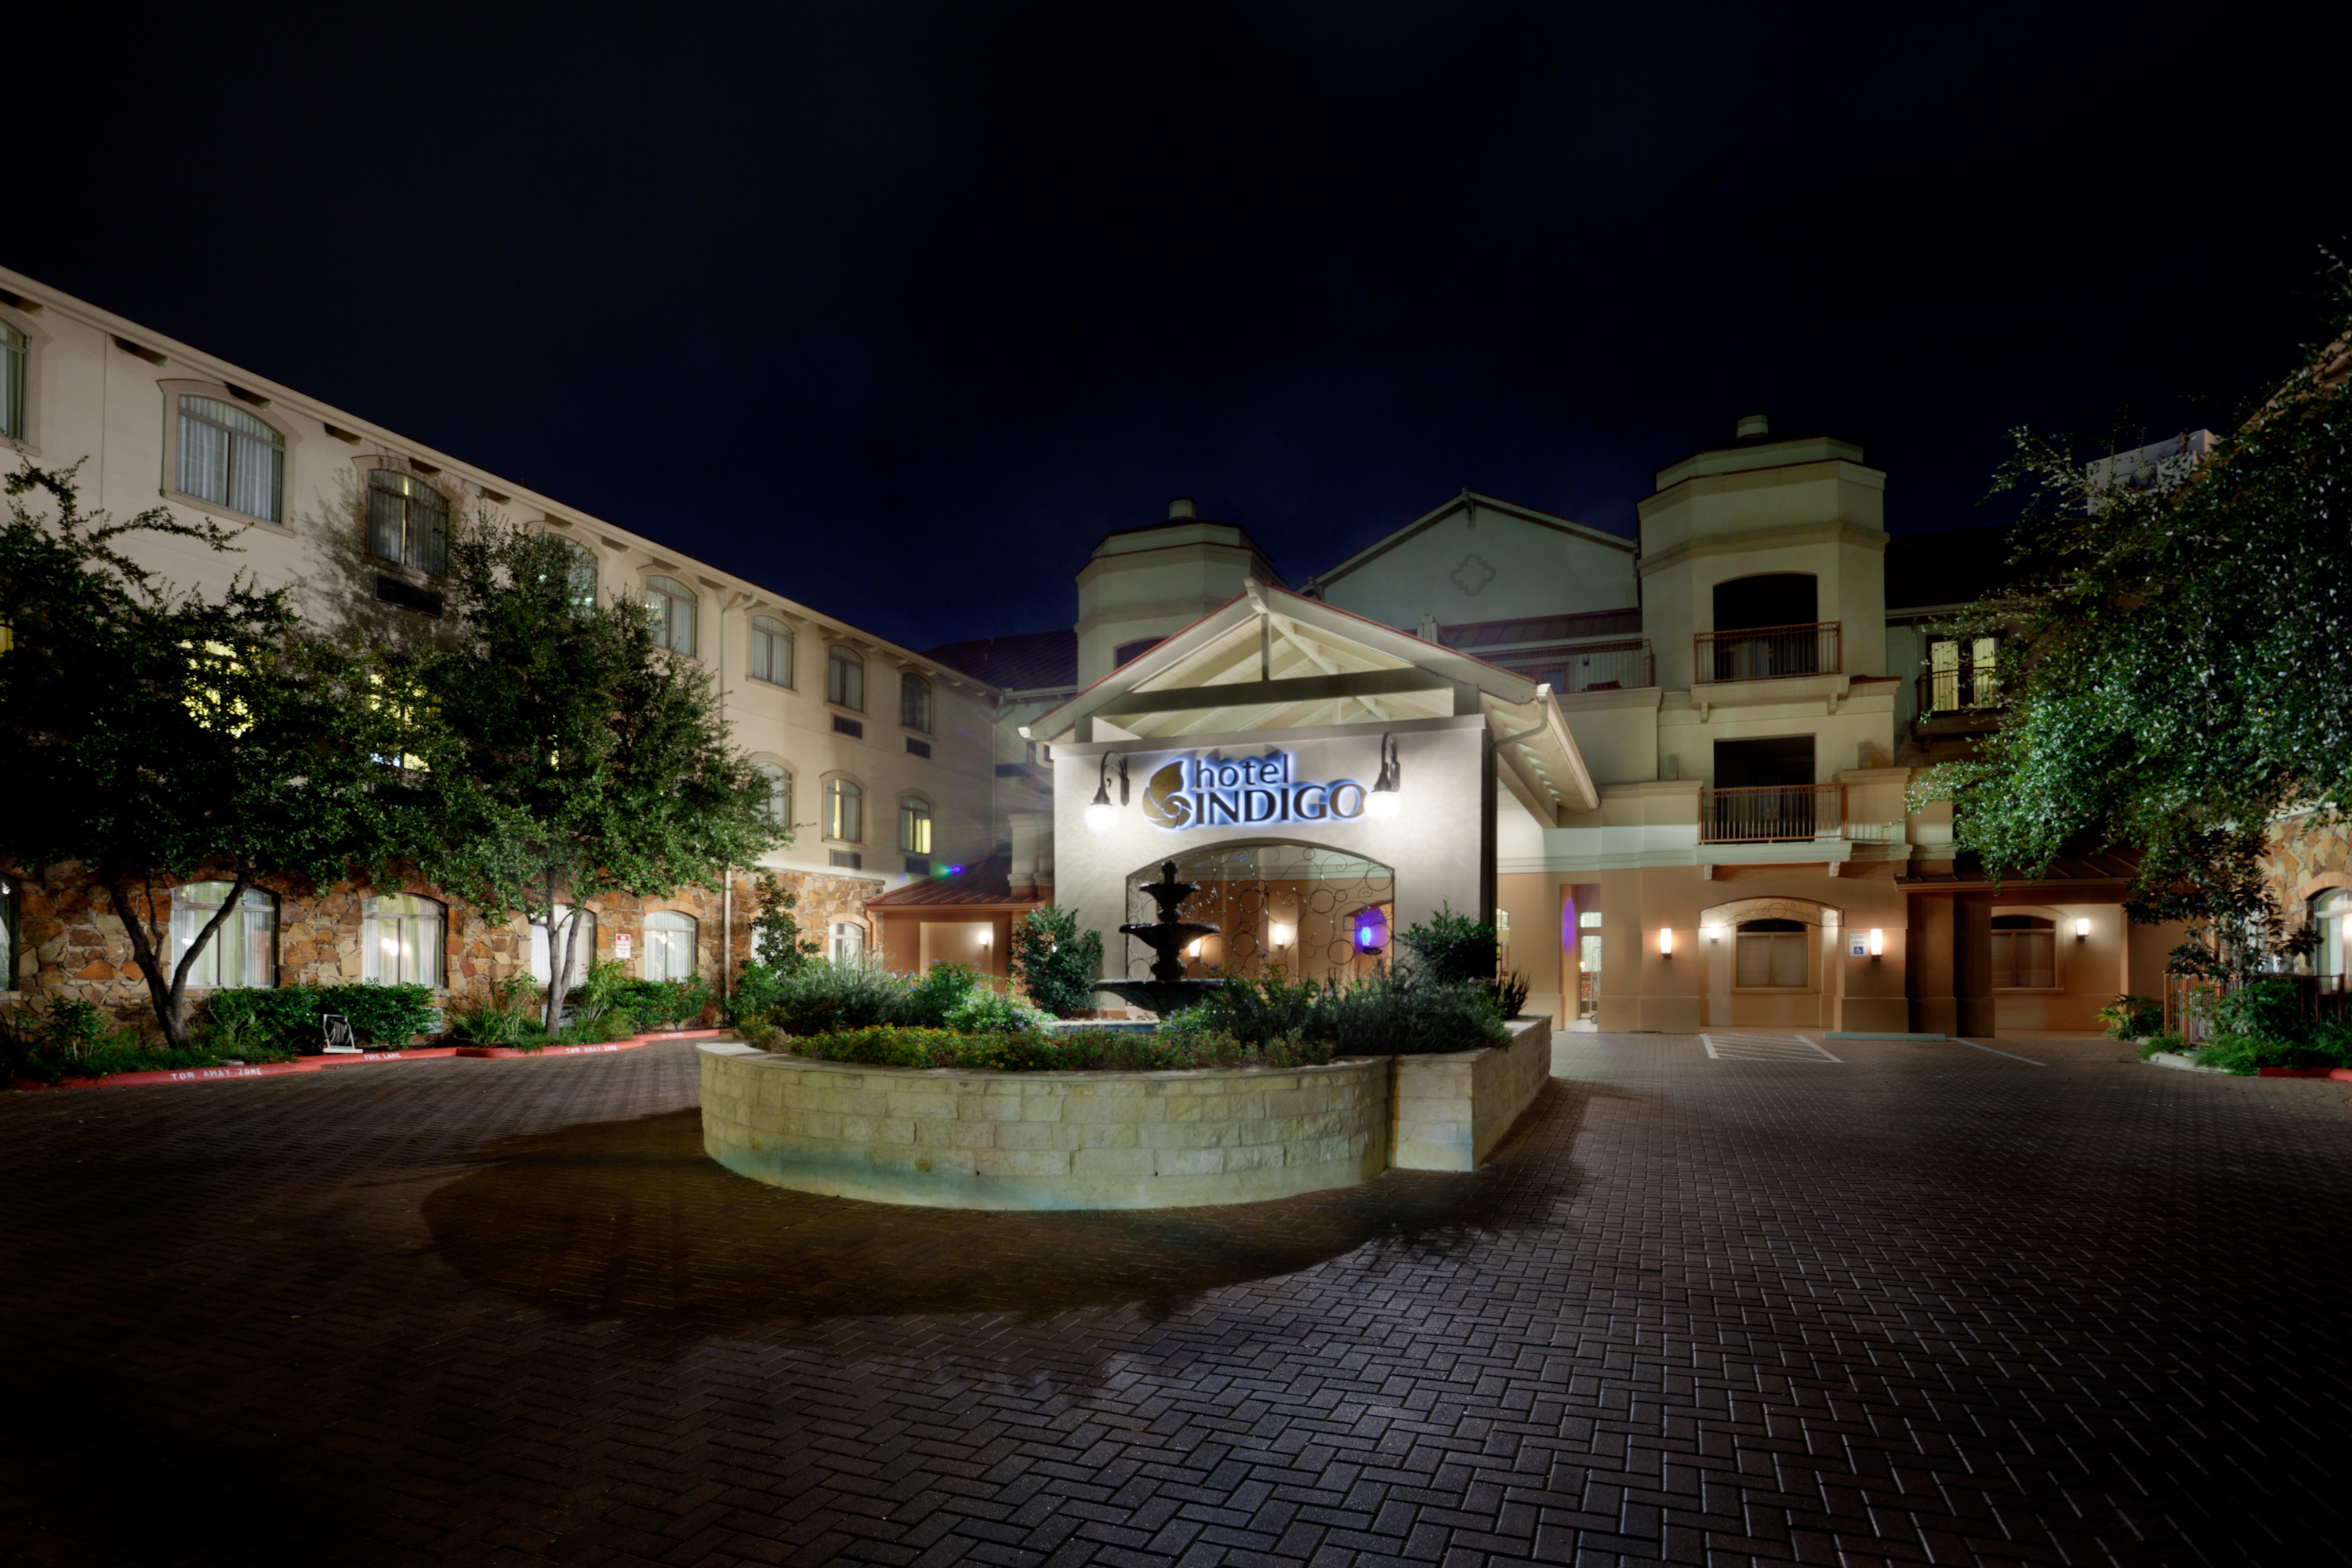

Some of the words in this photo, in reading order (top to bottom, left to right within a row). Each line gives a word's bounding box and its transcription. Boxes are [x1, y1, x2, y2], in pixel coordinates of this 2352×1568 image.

[1196, 753, 1289, 789] hotel
[1196, 785, 1368, 823] INDIGO
[171, 1072, 194, 1081] TOW
[203, 1069, 230, 1077] AWAY
[237, 1067, 263, 1076] ZONE
